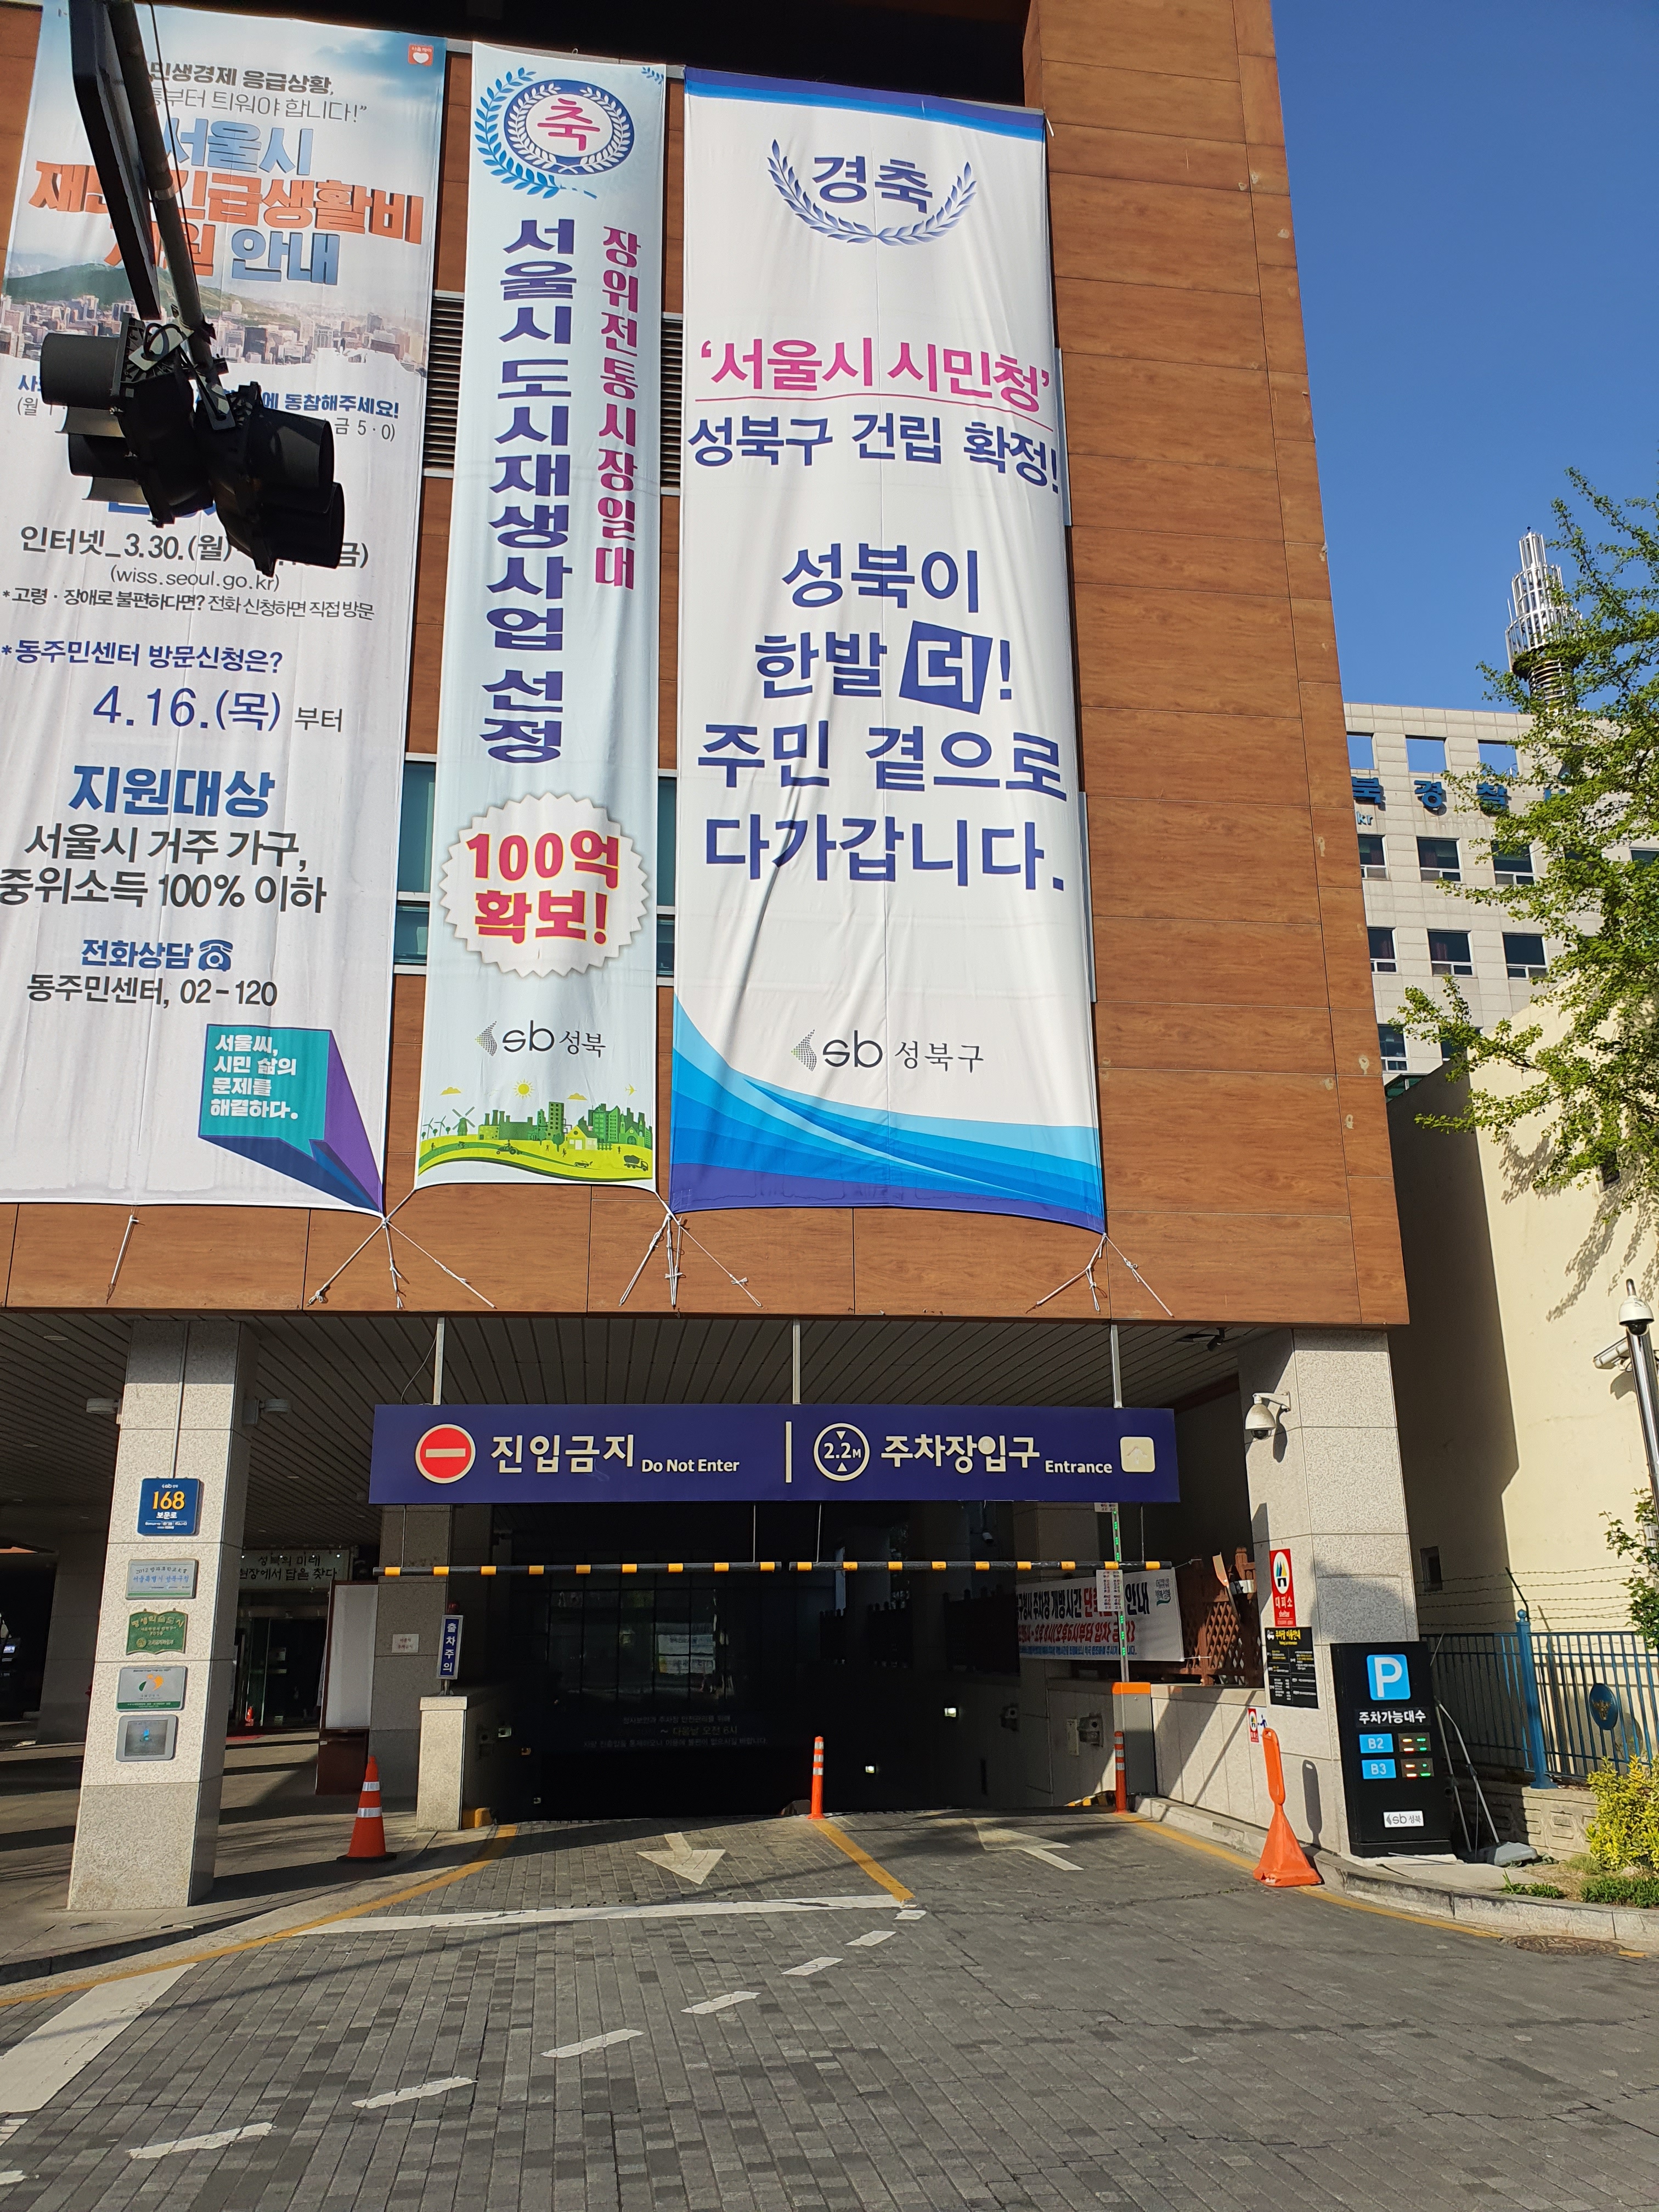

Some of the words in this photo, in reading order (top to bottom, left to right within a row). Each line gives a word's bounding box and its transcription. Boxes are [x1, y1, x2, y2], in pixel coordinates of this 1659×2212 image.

[243, 70, 334, 95] 응급상황,
[211, 91, 281, 116] 틔워야
[537, 98, 601, 151] 축
[165, 117, 313, 176] 서울시
[812, 156, 933, 214] 경축
[232, 229, 341, 286] 안내
[285, 393, 399, 419] 동참해주세요!
[689, 414, 833, 467] 성북구
[851, 414, 942, 465] 건립
[963, 421, 1060, 494] 확정!
[110, 565, 280, 592] (wiss.seoul.go.kr)
[782, 543, 980, 613] 성북이
[149, 645, 283, 673] 방문신청은?
[755, 632, 888, 699] 한발
[93, 685, 281, 731] 4.16.(목)
[294, 707, 343, 733] 부터
[697, 720, 831, 789] 주민
[865, 725, 1067, 802] 곁으로
[69, 765, 275, 818] 지원대상
[24, 823, 137, 863] 서울시
[148, 828, 219, 865] 거주
[228, 830, 307, 872] 가구,
[466, 830, 620, 890] 100억
[707, 814, 1064, 892] 다가갑니다.
[0, 867, 149, 908] 중위소득
[158, 873, 245, 909] 100%
[255, 876, 328, 914] 이하
[475, 891, 607, 944] 확보!
[81, 939, 194, 970] 전화상담
[26, 974, 170, 1009] 동주민센터,
[215, 1034, 278, 1057] 서울씨,
[560, 1030, 607, 1059] 성북
[894, 1040, 984, 1073] 성북구
[213, 1056, 252, 1074] 시민
[257, 1056, 297, 1076] 삶의
[212, 1077, 272, 1097] 문제를
[211, 1099, 299, 1121] 해결하다.
[491, 1434, 634, 1474] 진입금지
[642, 1459, 663, 1472] Do
[666, 1458, 695, 1472] Not
[698, 1458, 740, 1472] Enter
[881, 1434, 1040, 1474] 주차장입구
[1045, 1459, 1113, 1474] Entrance
[152, 1491, 185, 1510] 168
[156, 1511, 178, 1520] 보문로
[286, 1567, 309, 1581] 답을
[313, 1567, 337, 1581] 찾다
[296, 1555, 320, 1567] 미래
[1125, 1582, 1150, 1615] 안내
[1274, 1596, 1293, 1609] 대피소
[443, 1622, 457, 1673] 출차주의
[1374, 1656, 1404, 1698] P
[1359, 1709, 1426, 1724] 주차가능대수
[1368, 1737, 1384, 1750] B2
[1370, 1763, 1386, 1775] B3
[1392, 1813, 1407, 1824] sb
[1408, 1814, 1421, 1824] 성북
